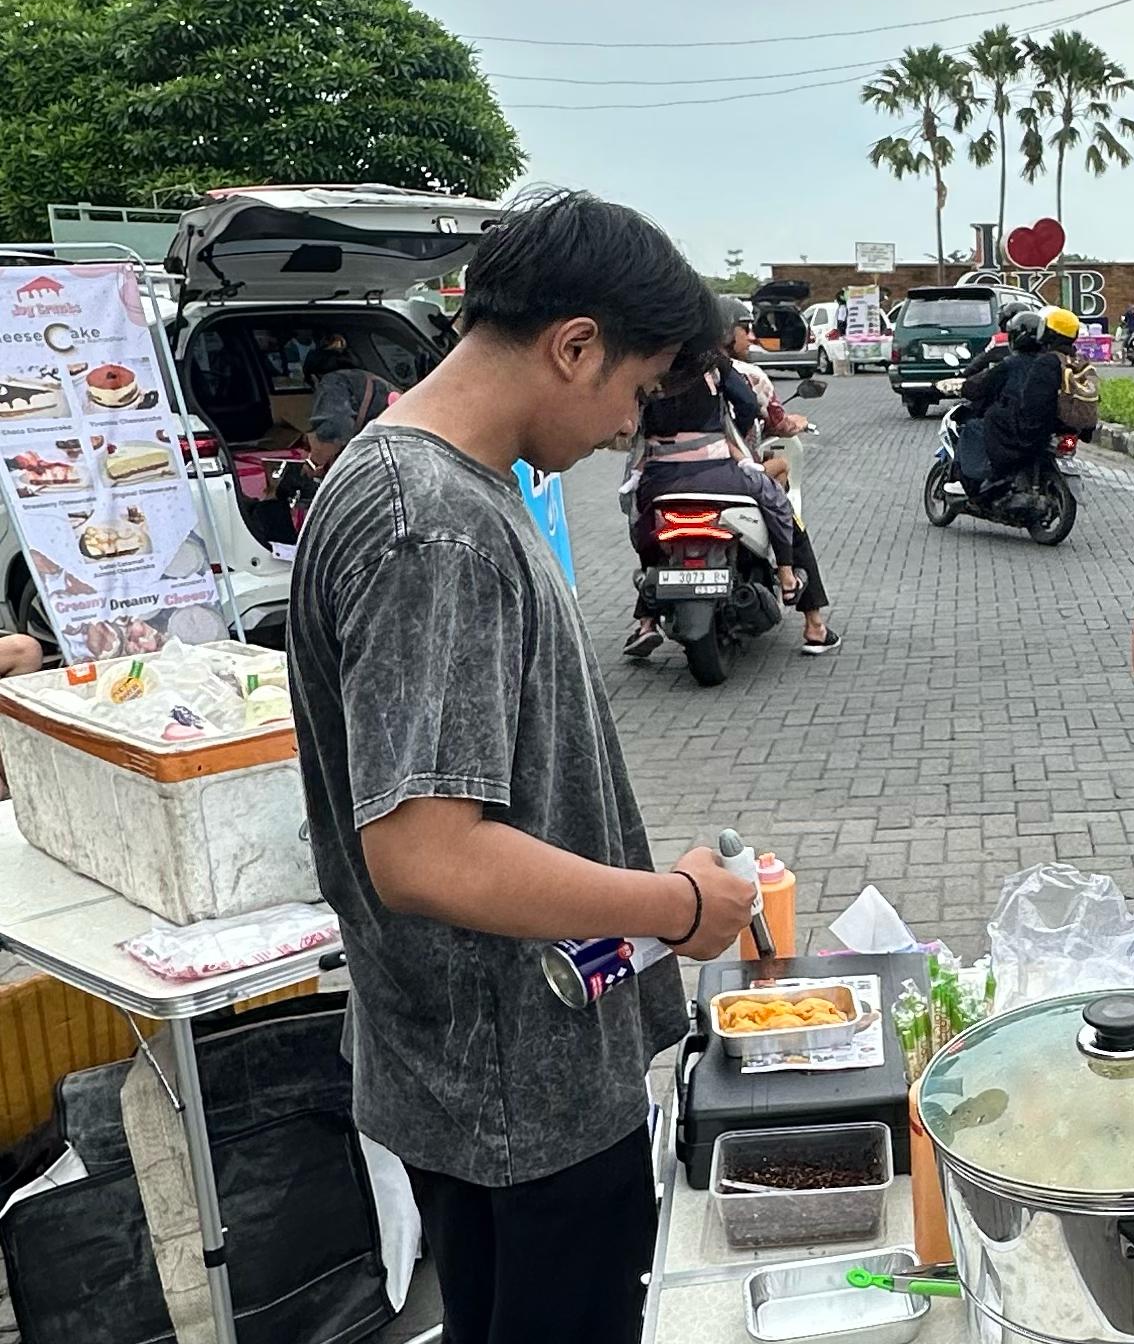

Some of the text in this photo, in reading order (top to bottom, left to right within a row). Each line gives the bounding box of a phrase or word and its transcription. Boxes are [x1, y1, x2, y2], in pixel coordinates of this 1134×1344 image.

[970, 224, 1001, 271] I
[55, 589, 215, 613] Creamy Dreamy Cheesy
